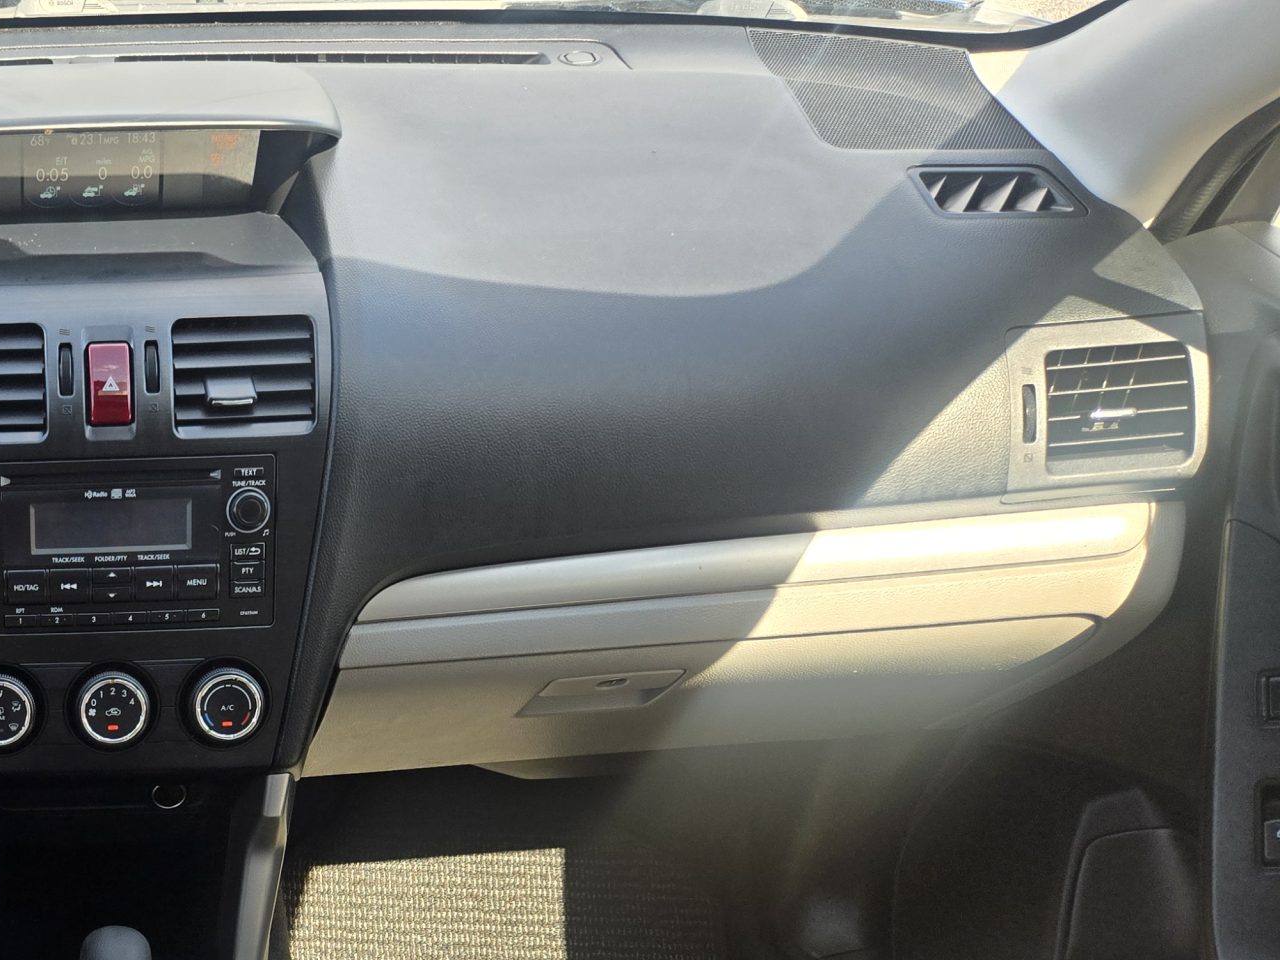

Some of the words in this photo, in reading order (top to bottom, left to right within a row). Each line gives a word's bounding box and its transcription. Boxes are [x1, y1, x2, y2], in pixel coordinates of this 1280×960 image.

[128, 131, 156, 144] 18:43
[36, 167, 69, 182] 0:05
[98, 166, 108, 180] 0
[131, 165, 153, 180] 0.0
[241, 469, 257, 477] TEXT
[231, 480, 267, 488] TUNE/TRACK
[51, 556, 85, 564] TRACK/SEEK
[94, 555, 128, 563] FOLDER/PTY
[137, 553, 171, 561] TRACK/SEEK
[241, 567, 254, 575] PTY
[186, 578, 207, 587] MENU
[13, 584, 39, 592] HD/TAG
[110, 687, 117, 696] 2
[121, 689, 128, 698] 3
[90, 698, 97, 707] 0
[129, 697, 135, 705] 4
